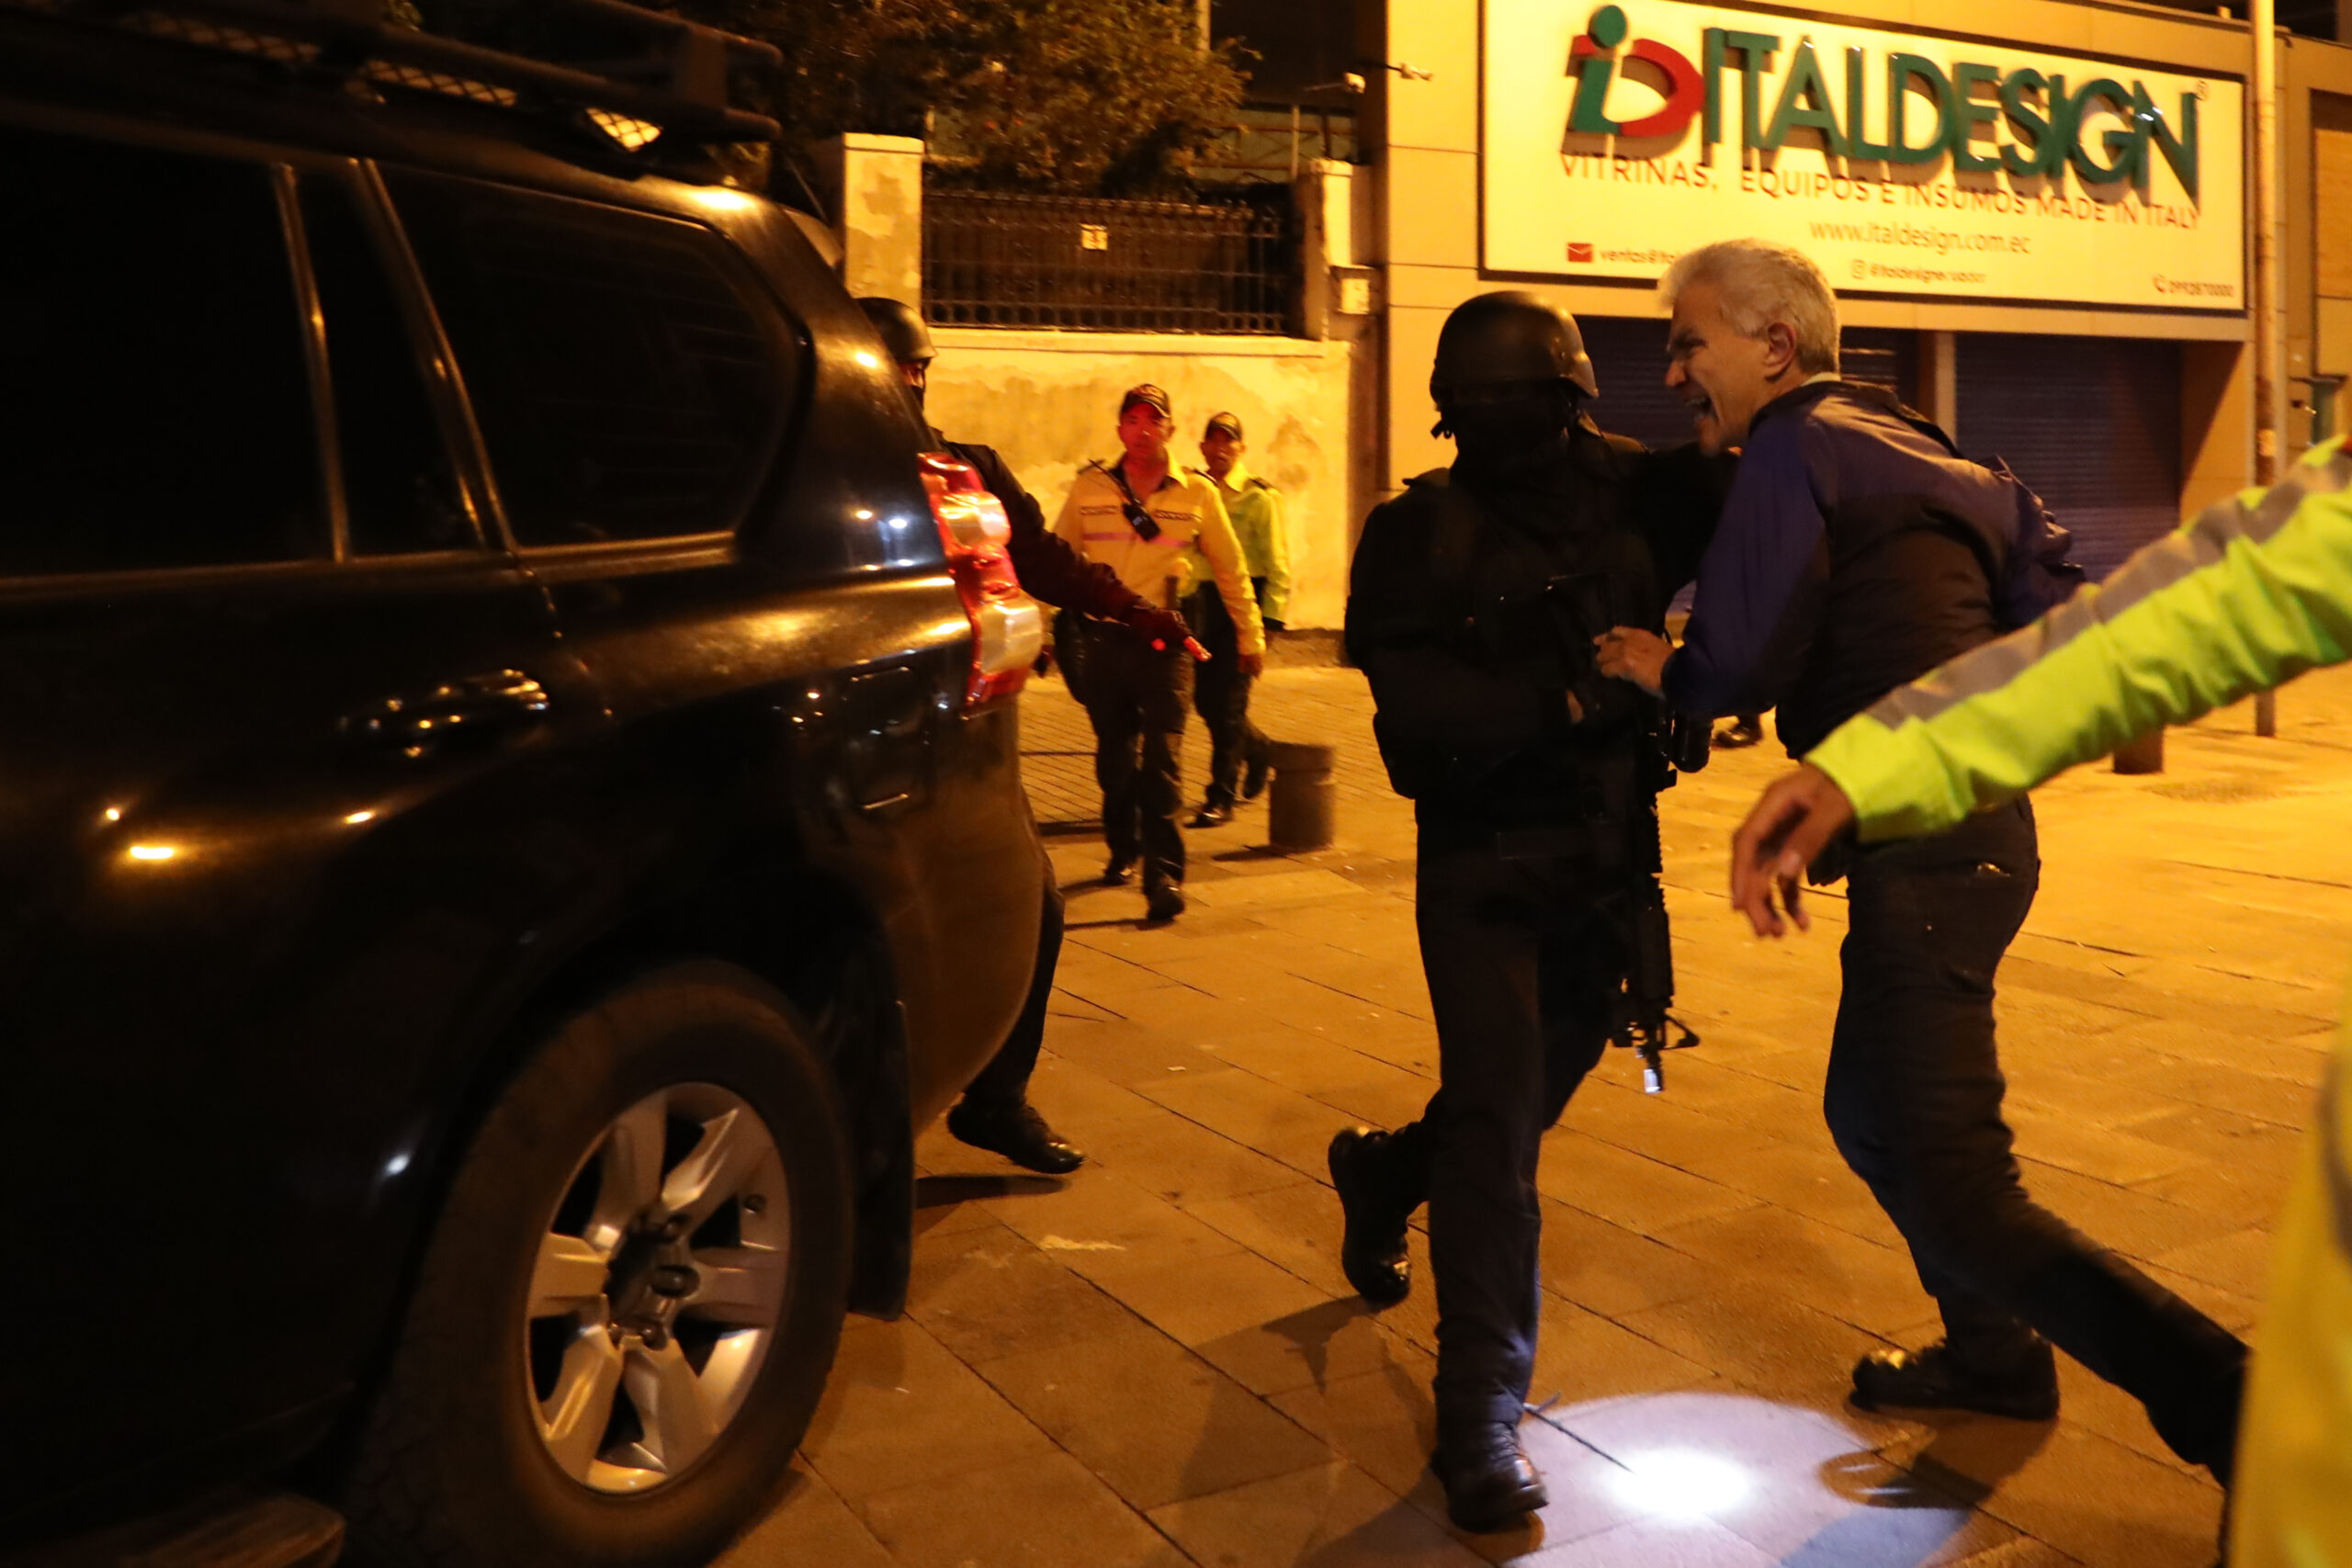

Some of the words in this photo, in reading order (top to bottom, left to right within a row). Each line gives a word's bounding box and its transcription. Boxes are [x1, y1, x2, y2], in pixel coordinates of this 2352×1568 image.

[1702, 28, 2199, 208] ITALDESIGN
[1560, 153, 1716, 191] VITRINAS,
[1742, 167, 1871, 200] EQUIPOS
[1881, 179, 1895, 204] E
[1905, 183, 2028, 215] INSUMOS
[2036, 195, 2107, 221] MADE
[2114, 200, 2139, 225] IN
[2146, 204, 2200, 230] ITALY
[1809, 221, 2030, 255] www.italdesign.com.ec
